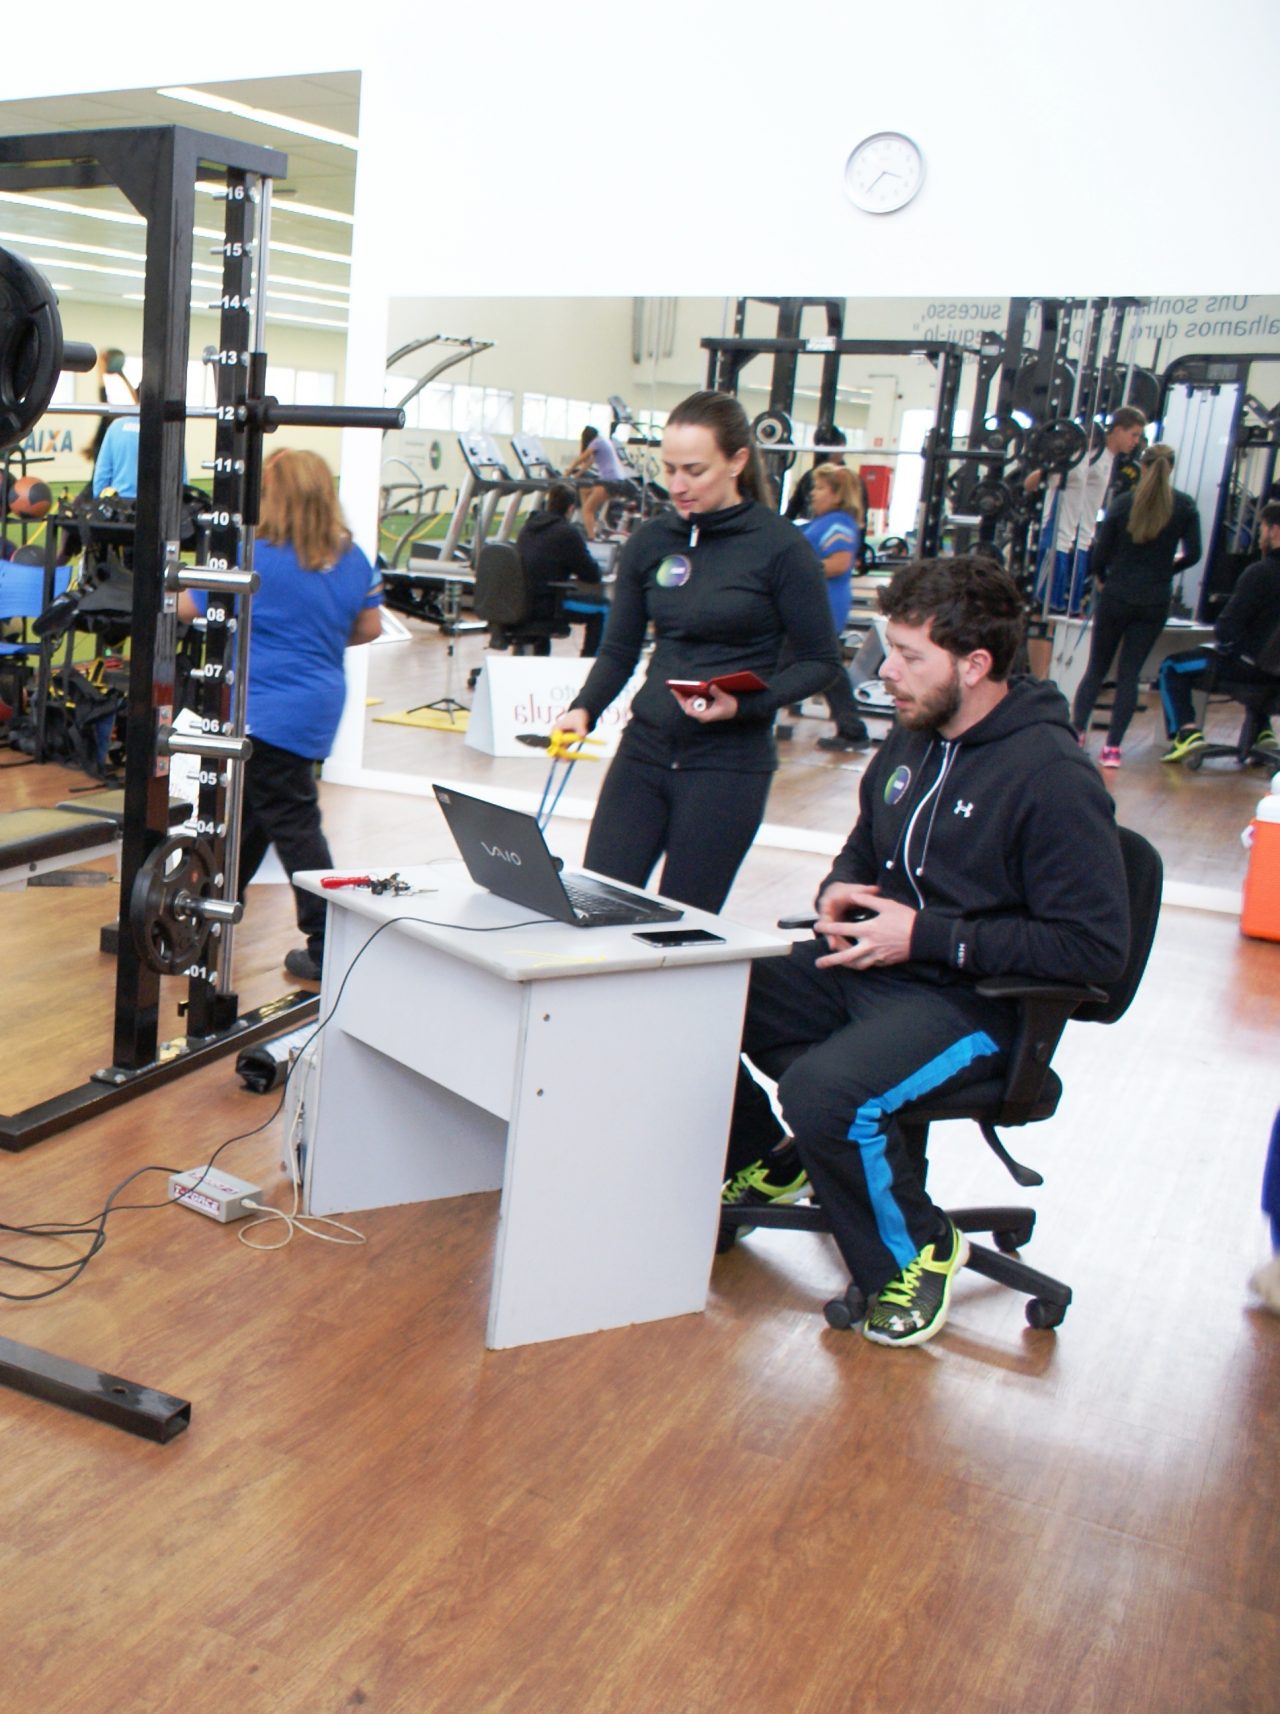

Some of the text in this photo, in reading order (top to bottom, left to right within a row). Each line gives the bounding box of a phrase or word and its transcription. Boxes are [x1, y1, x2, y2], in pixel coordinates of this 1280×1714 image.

[227, 185, 245, 200] 16
[224, 242, 242, 257] 15
[222, 294, 240, 310] 14
[220, 350, 238, 366] 13
[217, 405, 235, 421] 12
[23, 430, 74, 453] AIXA
[215, 457, 232, 473] 11
[212, 510, 230, 526] 10
[209, 557, 228, 571] 09
[207, 607, 225, 623] 08
[204, 663, 224, 678] 07
[201, 717, 220, 733] 06
[199, 770, 218, 786] 05
[196, 819, 215, 835] 04
[480, 841, 522, 866] VAIO
[189, 964, 207, 980] 01
